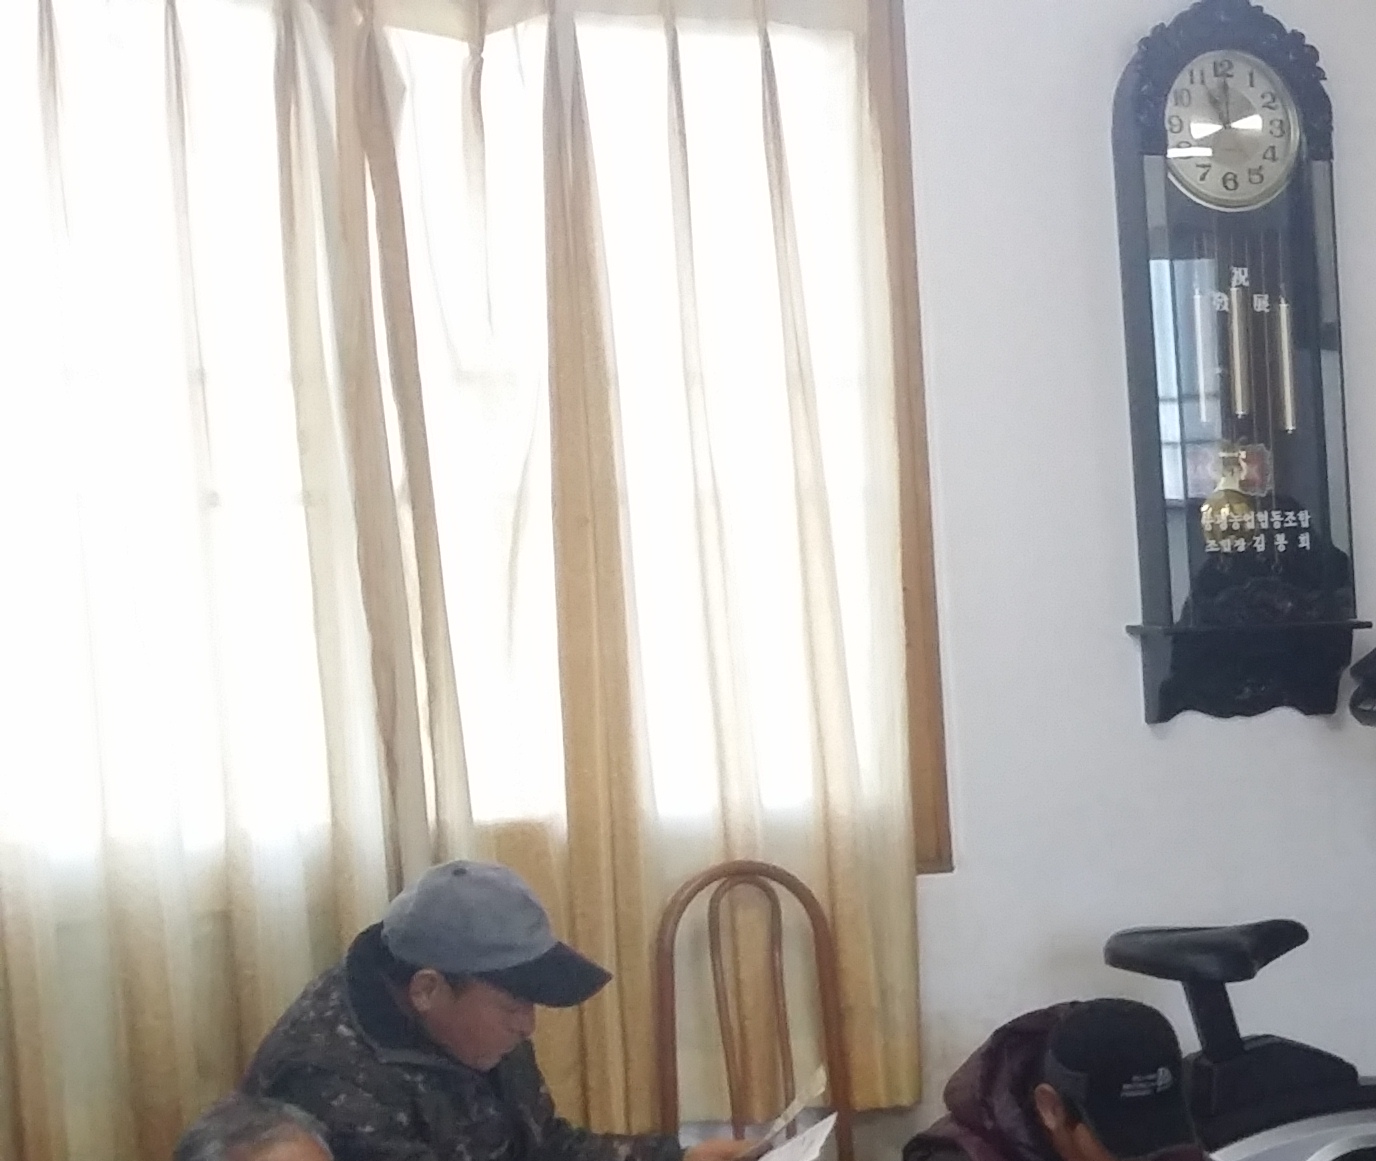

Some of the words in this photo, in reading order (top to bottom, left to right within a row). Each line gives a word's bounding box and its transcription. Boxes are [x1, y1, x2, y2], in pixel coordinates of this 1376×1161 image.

[1189, 69, 1205, 86] 11
[1213, 59, 1234, 78] 12
[1248, 70, 1255, 88] 1
[1173, 88, 1191, 107] 10
[1260, 91, 1277, 111] 2
[1167, 115, 1183, 134] 9
[1269, 118, 1286, 138] 3
[1262, 145, 1279, 162] 4
[1195, 163, 1212, 182] 7
[1222, 171, 1240, 191] 6
[1248, 165, 1265, 185] 5
